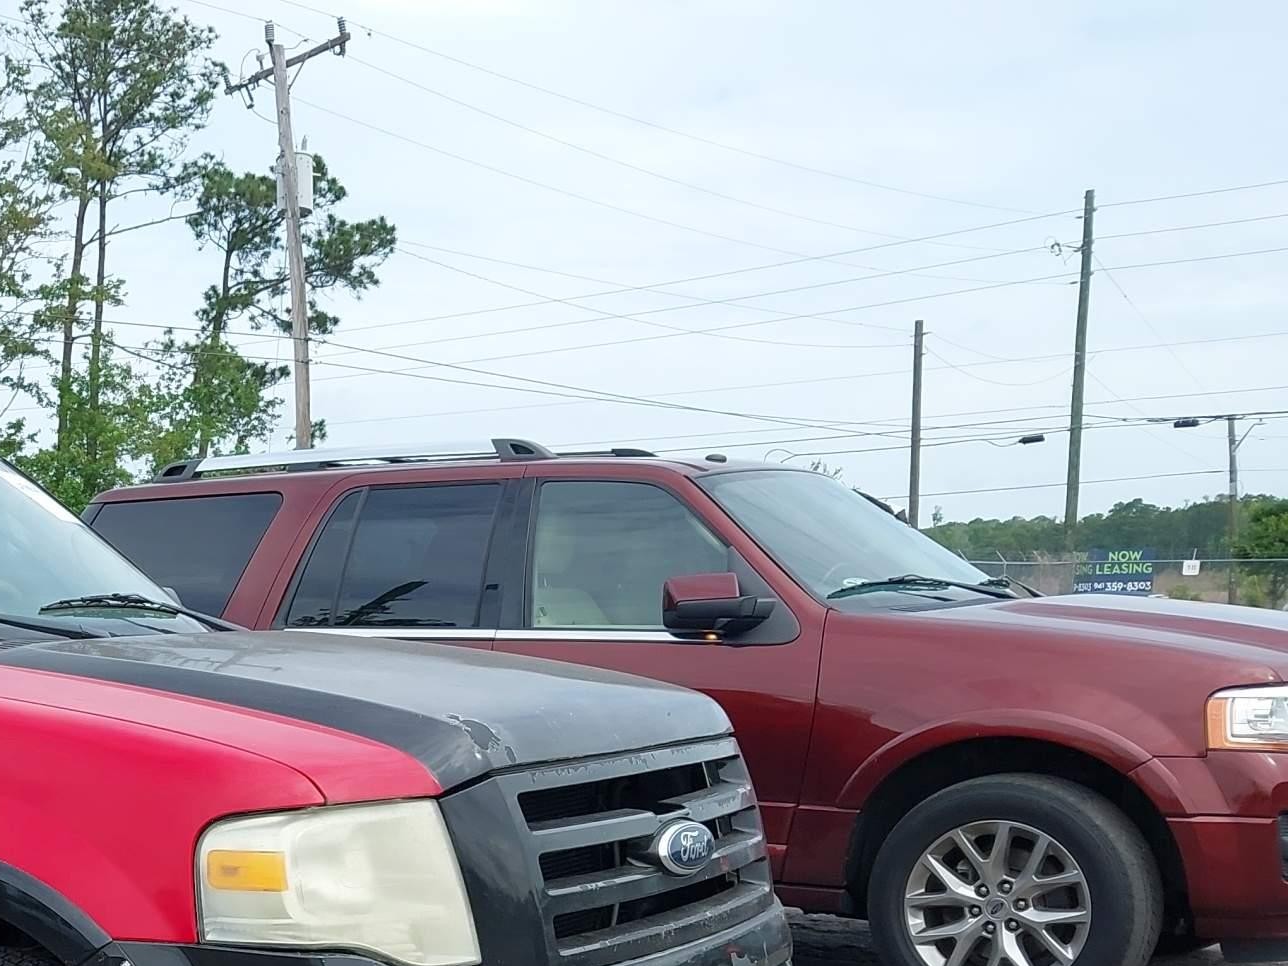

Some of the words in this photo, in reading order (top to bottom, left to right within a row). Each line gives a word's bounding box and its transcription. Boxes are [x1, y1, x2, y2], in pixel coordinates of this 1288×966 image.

[1108, 550, 1143, 562] NOW
[1095, 563, 1153, 575] LEASING
[680, 830, 709, 862] Ford
